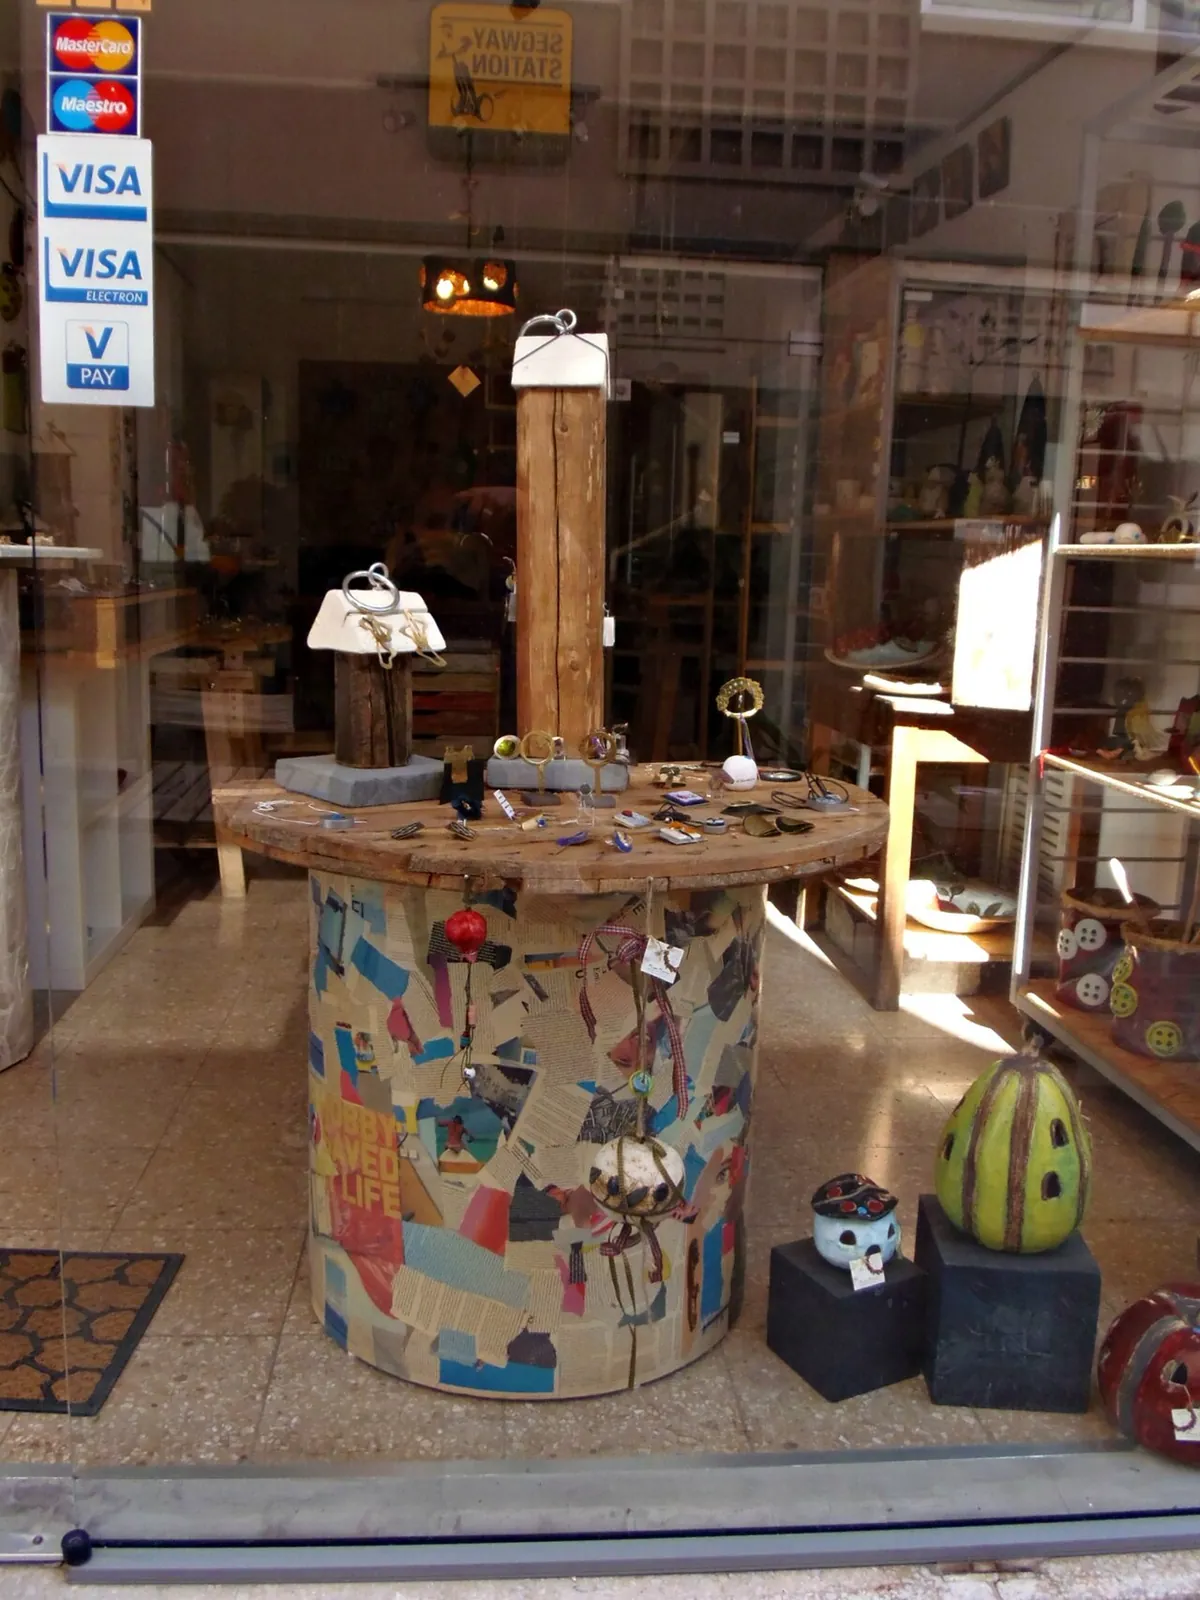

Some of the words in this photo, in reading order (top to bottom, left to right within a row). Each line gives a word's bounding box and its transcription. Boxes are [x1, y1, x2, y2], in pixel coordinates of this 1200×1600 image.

[55, 37, 132, 55] MasterCard
[61, 96, 128, 114] Maestro
[57, 163, 142, 196] VISA
[57, 247, 143, 280] VISA
[86, 290, 143, 303] ELECTRON
[80, 325, 113, 359] V
[81, 368, 116, 385] PAY
[341, 1173, 402, 1219] LIFE
